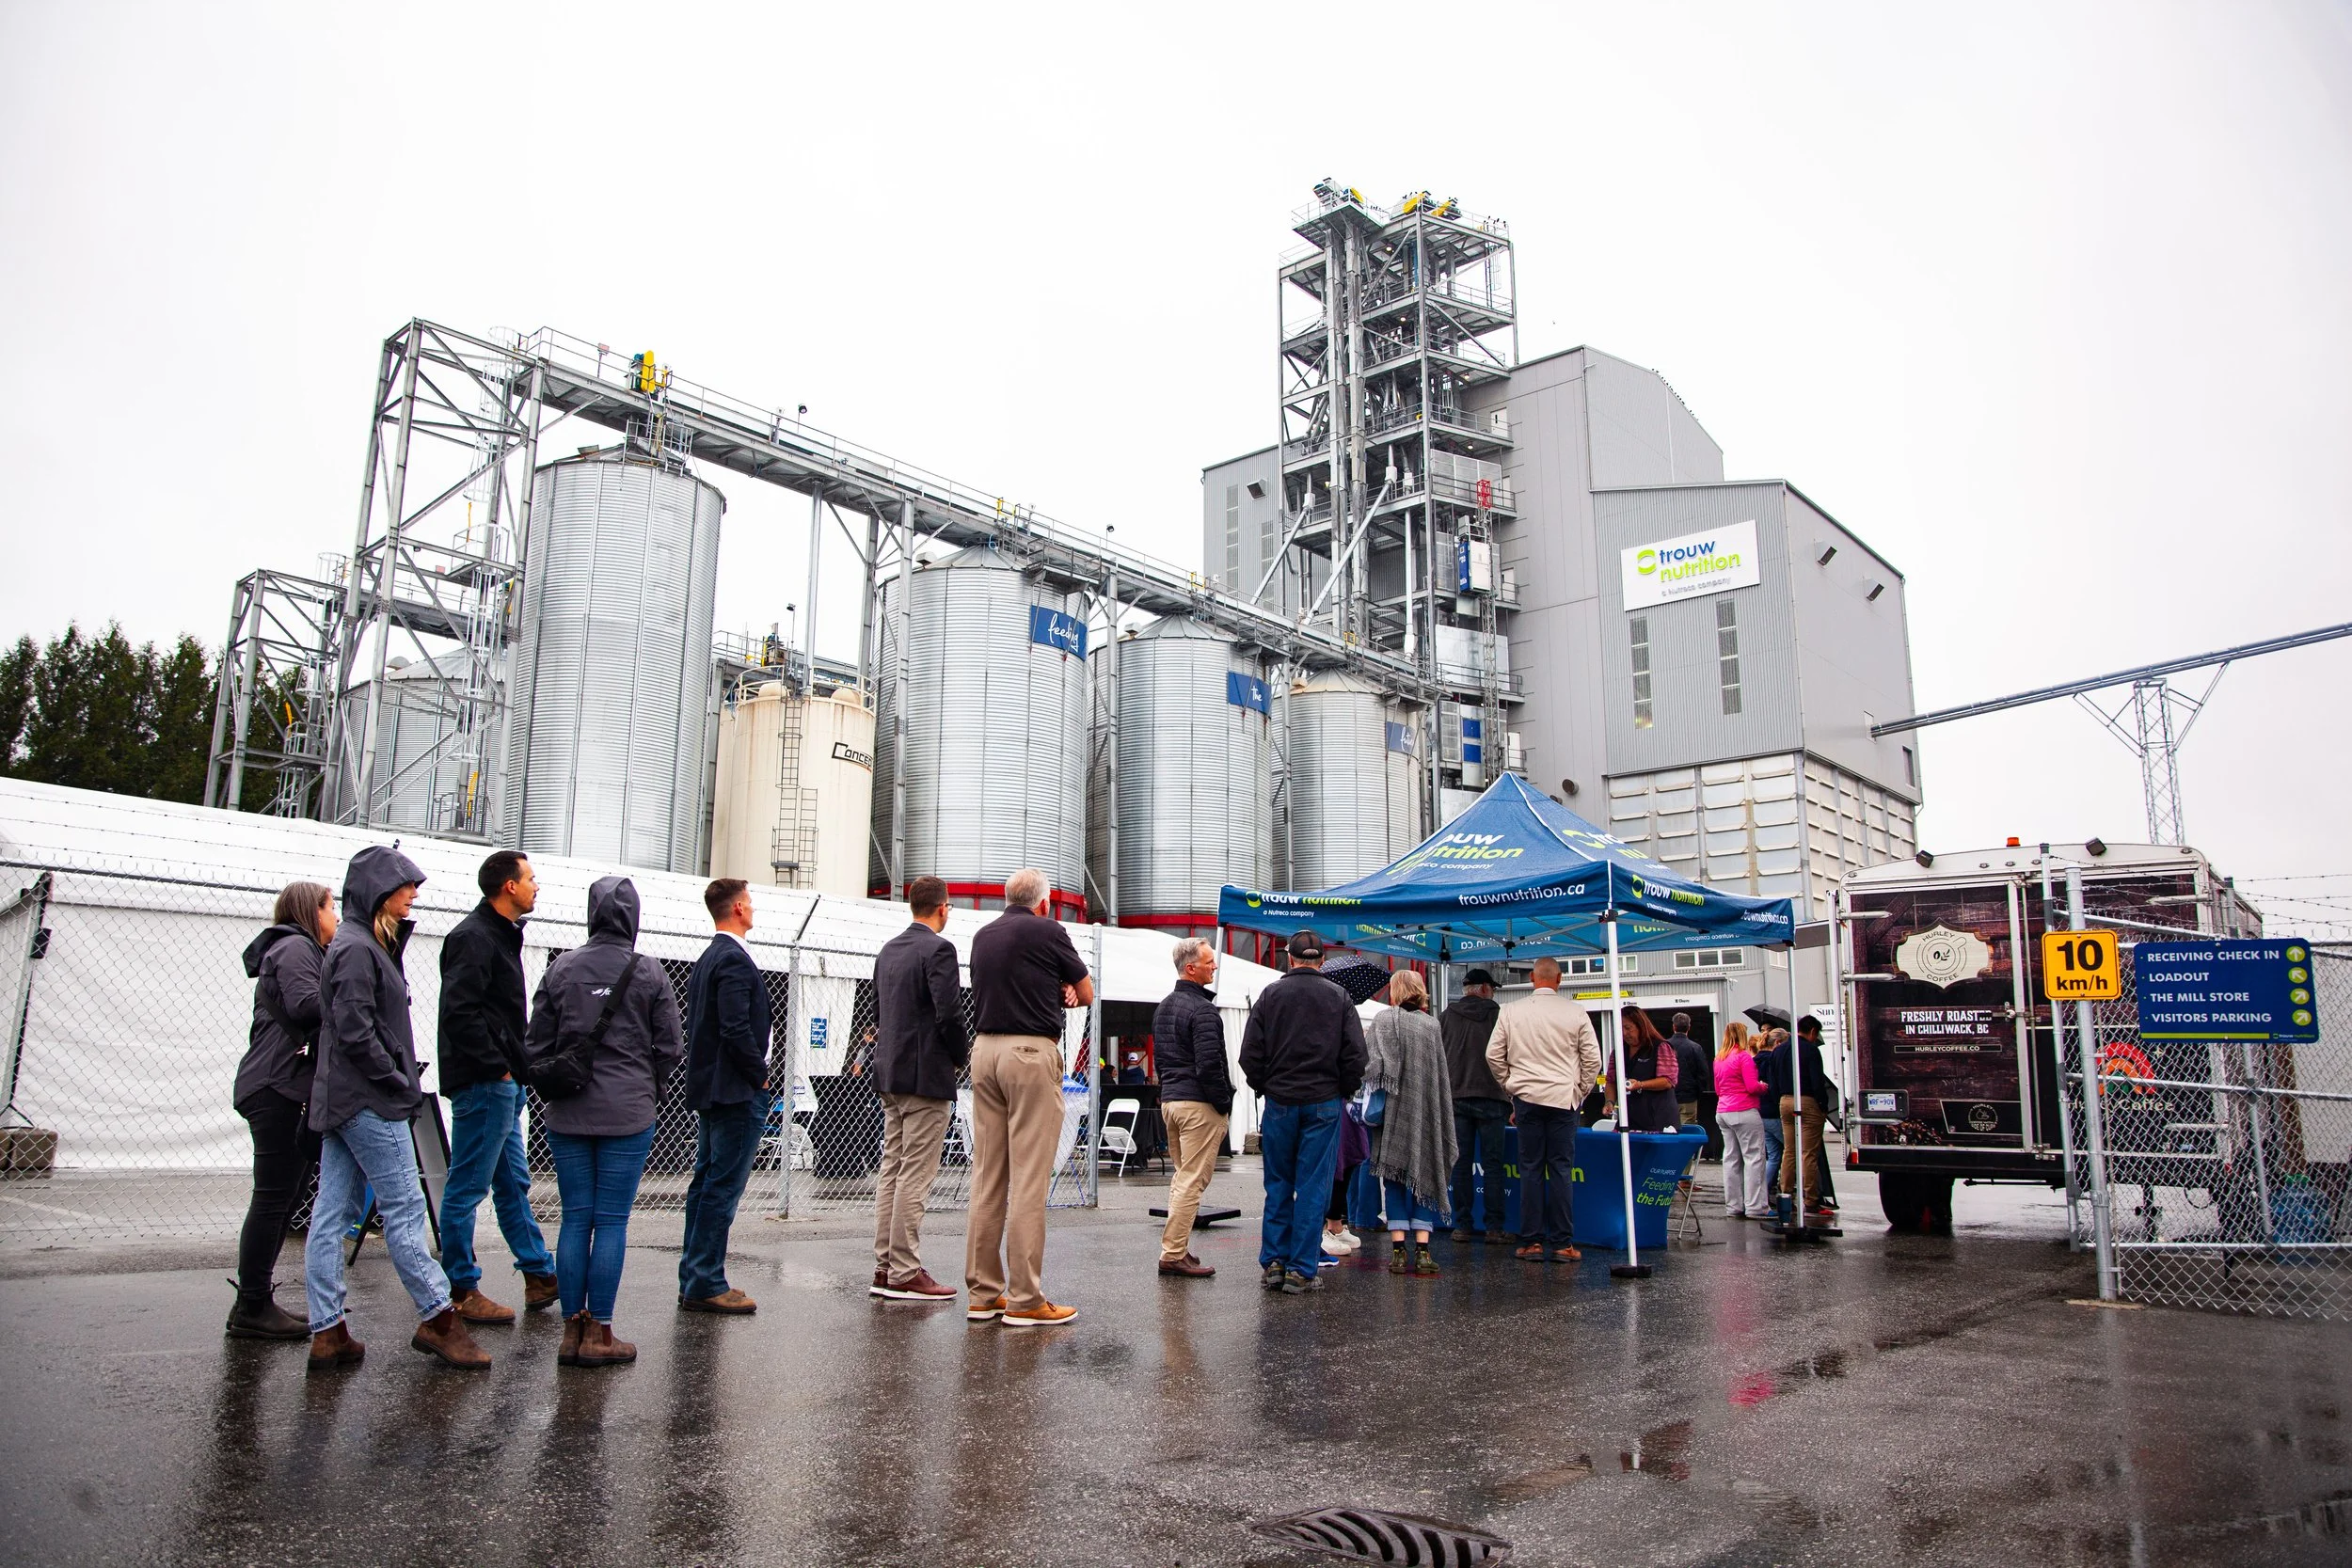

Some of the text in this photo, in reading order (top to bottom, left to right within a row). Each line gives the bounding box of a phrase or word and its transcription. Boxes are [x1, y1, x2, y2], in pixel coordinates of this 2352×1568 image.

[1659, 541, 1716, 564] trouw
[1660, 552, 1741, 582] nutrition
[1697, 577, 1732, 591] company
[1250, 685, 1263, 702] the
[1428, 845, 1524, 860] trition
[1440, 863, 1495, 871] company
[1458, 883, 1585, 905] trouwnutrition.ca
[1290, 910, 1314, 918] company
[1922, 930, 1956, 942] HURLEY
[2057, 939, 2104, 971] 10
[2147, 949, 2280, 962] RECEIVING CHECK IN
[1926, 973, 1960, 982] COFFEE
[2056, 974, 2108, 992] km/h
[2149, 972, 2210, 982] LOADOUT
[2150, 991, 2250, 1003] THE MILL STORE
[1900, 1010, 1945, 1022] FRESHLY
[2151, 1012, 2273, 1023] VISITORS PARKING
[1905, 1023, 1990, 1036] IN CHILLIWACK, BC
[1642, 1177, 1676, 1194] Feeding
[1636, 1192, 1673, 1206] the Futu
